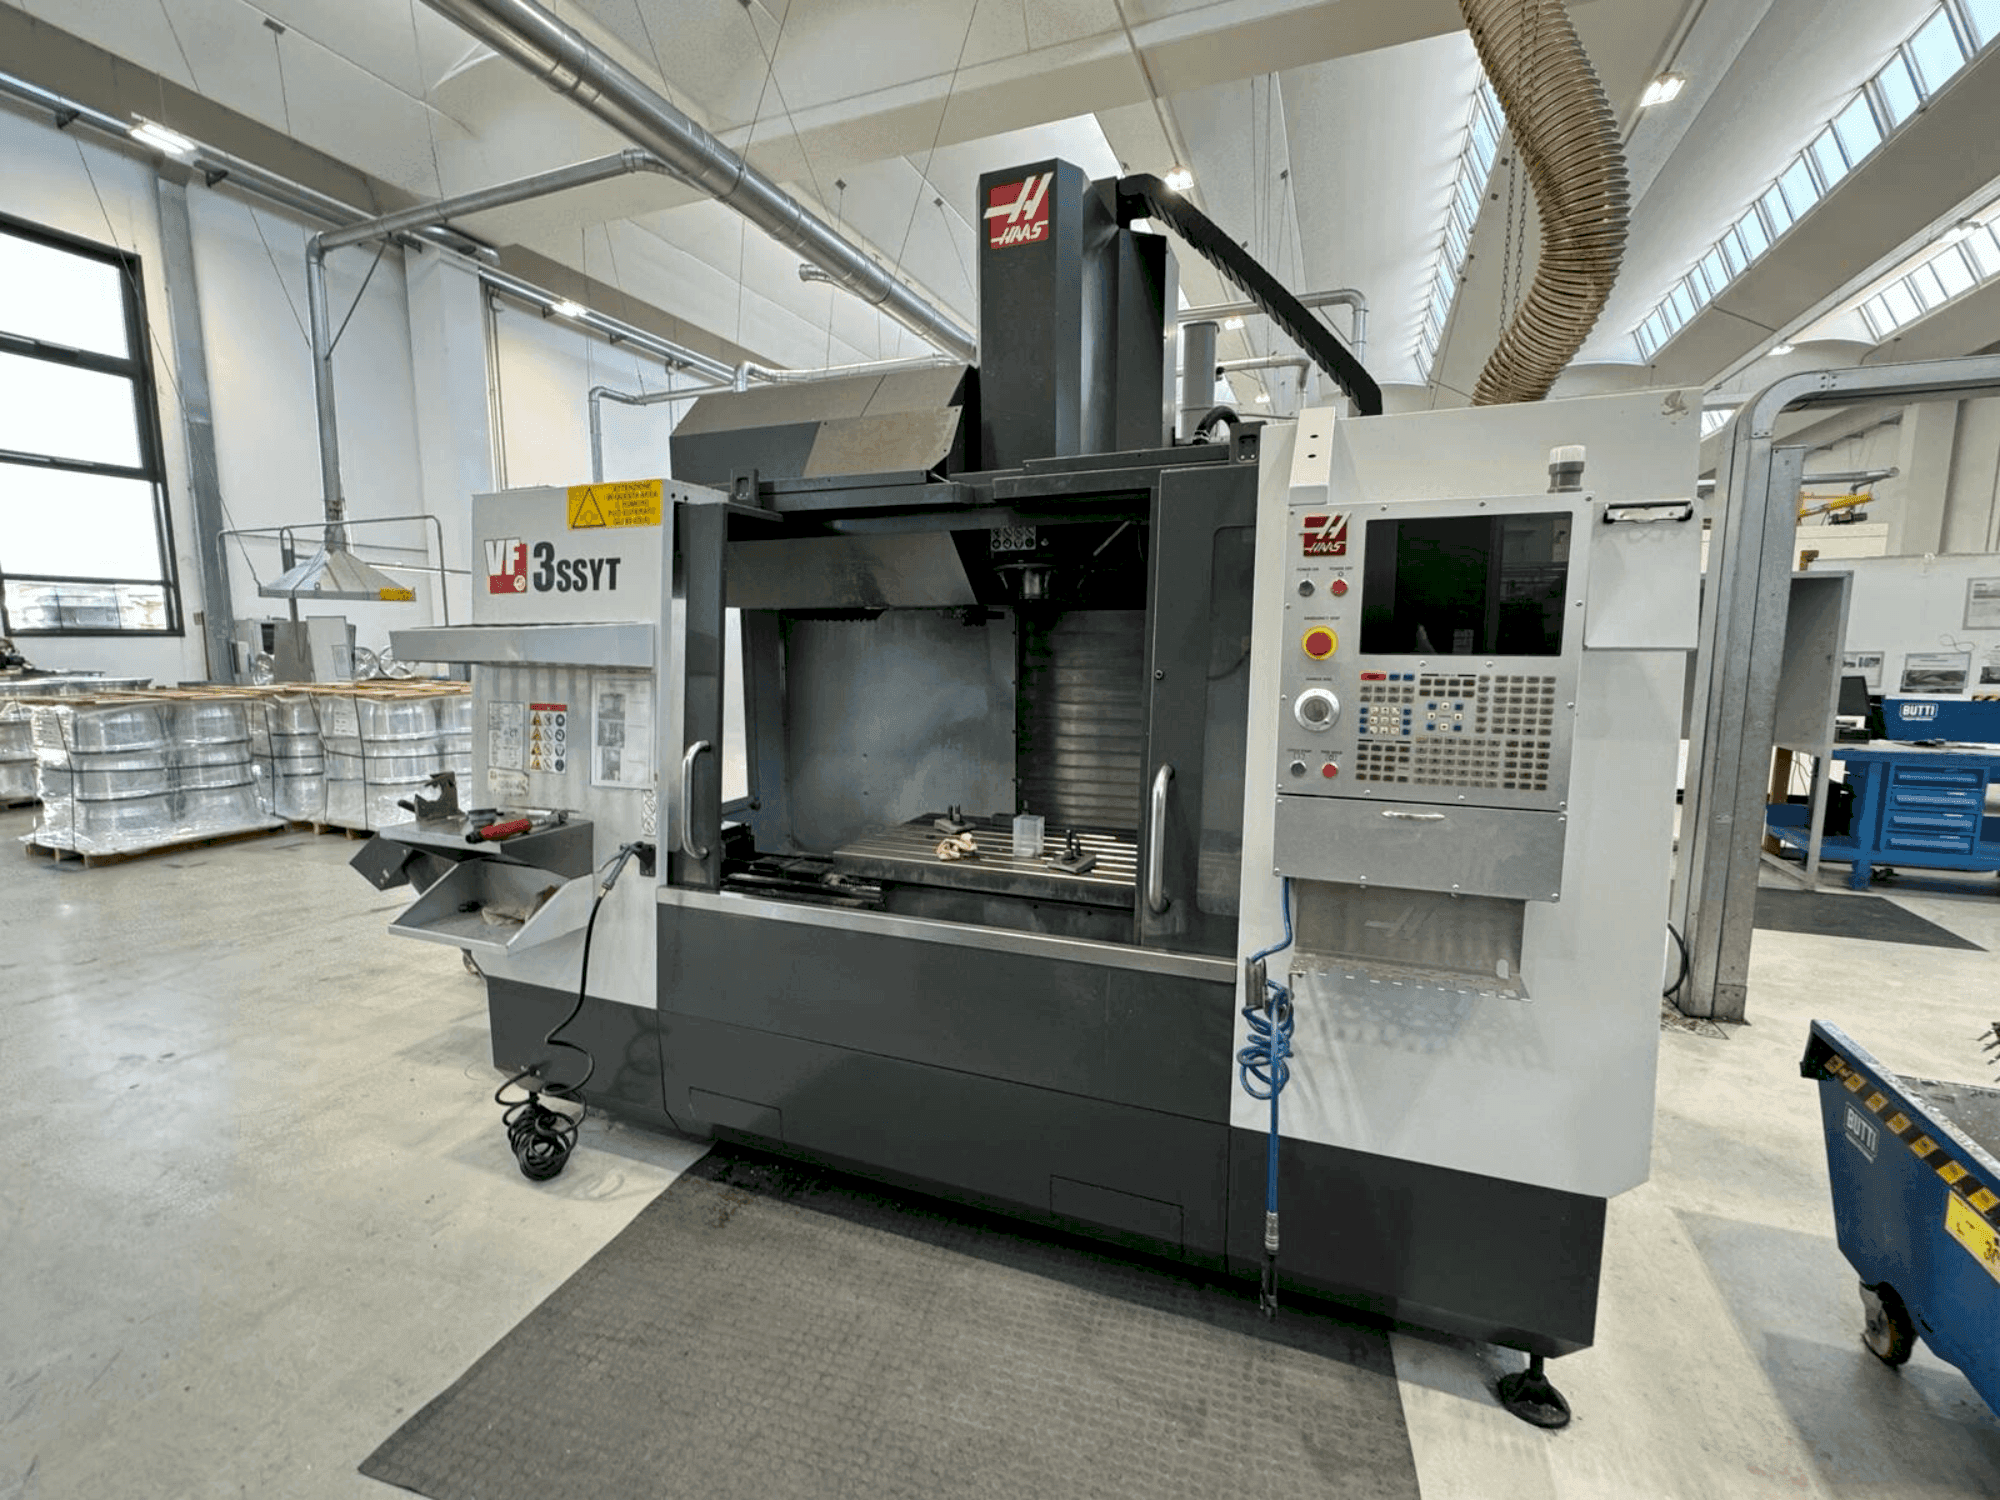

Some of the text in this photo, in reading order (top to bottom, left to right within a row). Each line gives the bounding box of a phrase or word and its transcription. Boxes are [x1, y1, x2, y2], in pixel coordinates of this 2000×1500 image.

[990, 219, 1049, 245] HAAS
[1304, 540, 1346, 553] HAAS
[484, 538, 621, 593] VF 3SSYT
[1902, 704, 1935, 716] BUTTI
[1846, 1107, 1876, 1152] BUTTI
